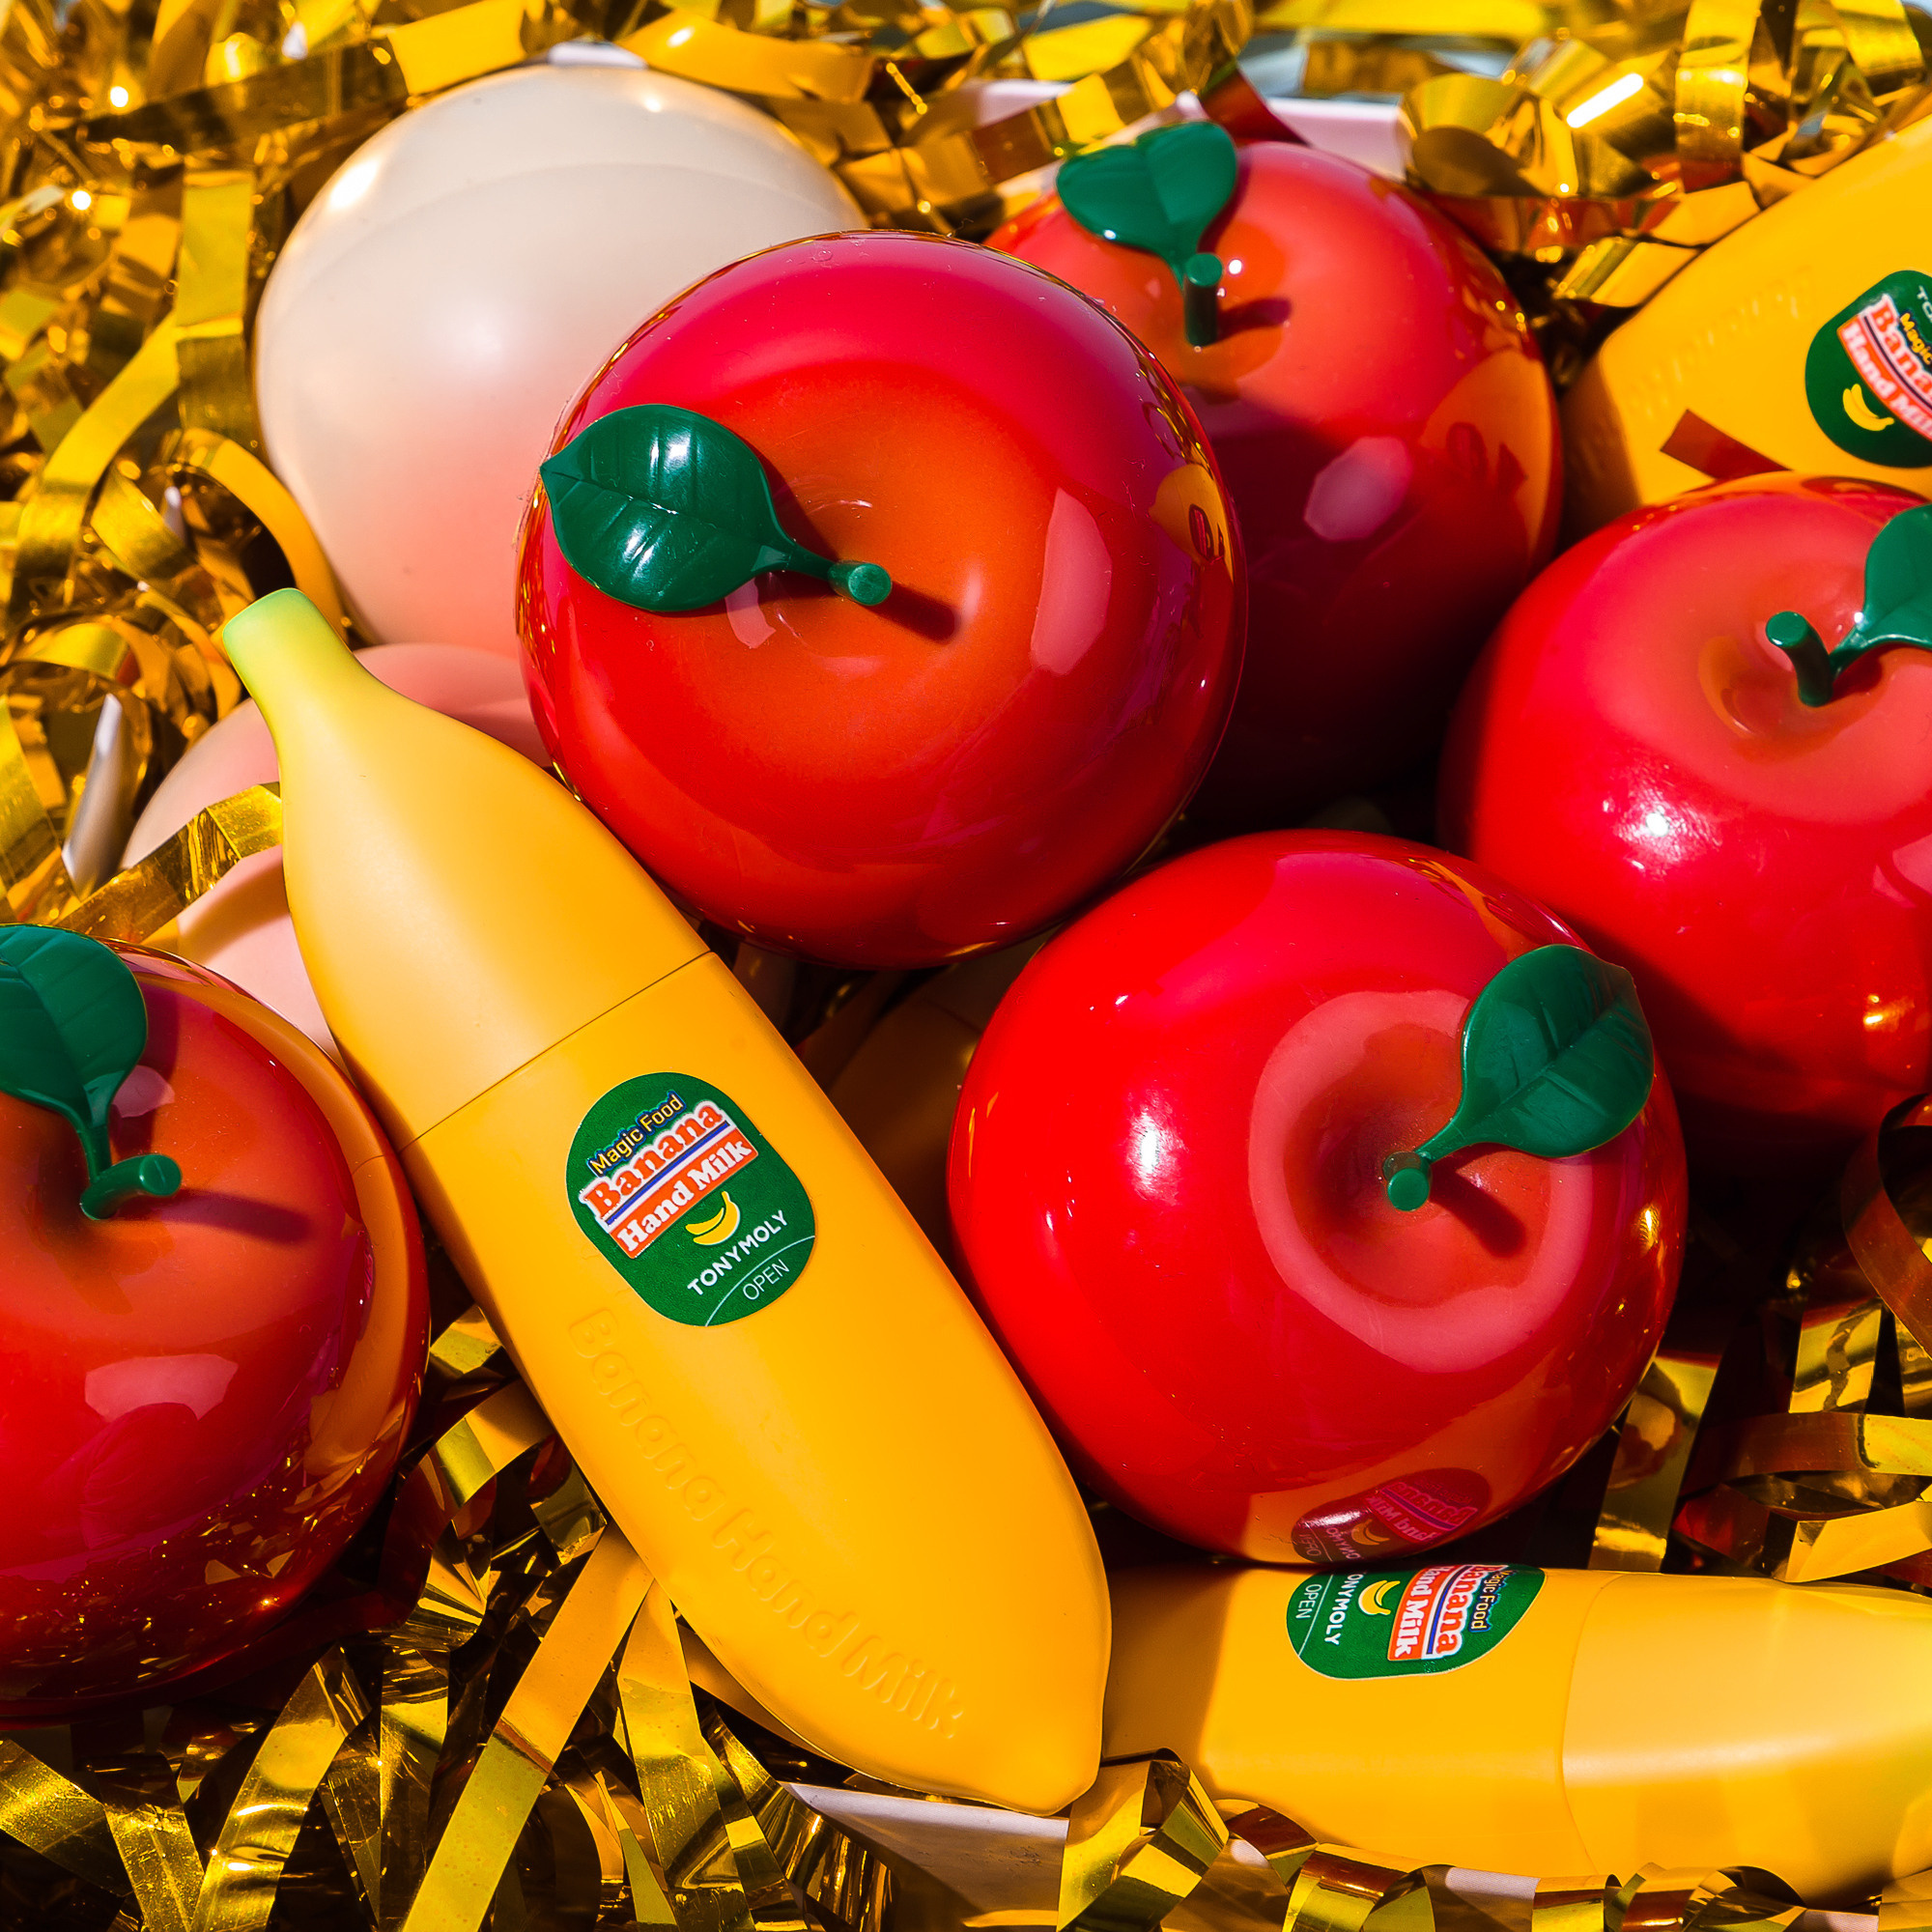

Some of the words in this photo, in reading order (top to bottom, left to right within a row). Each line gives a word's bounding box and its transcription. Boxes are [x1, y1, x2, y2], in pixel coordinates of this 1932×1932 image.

[581, 1102, 724, 1219] Banana
[588, 1125, 645, 1176] Magic
[639, 1093, 685, 1132] Food
[616, 1179, 695, 1252] Hand
[687, 1140, 753, 1192] Milk
[687, 1209, 788, 1295] TONYMOLY
[742, 1259, 790, 1300] OPEN
[1294, 1583, 1322, 1619] OPEN
[1323, 1573, 1364, 1646] ONYMOLY
[1394, 1599, 1429, 1659] Milk
[1470, 1595, 1495, 1630] Food
[839, 1634, 966, 1739] Milk
